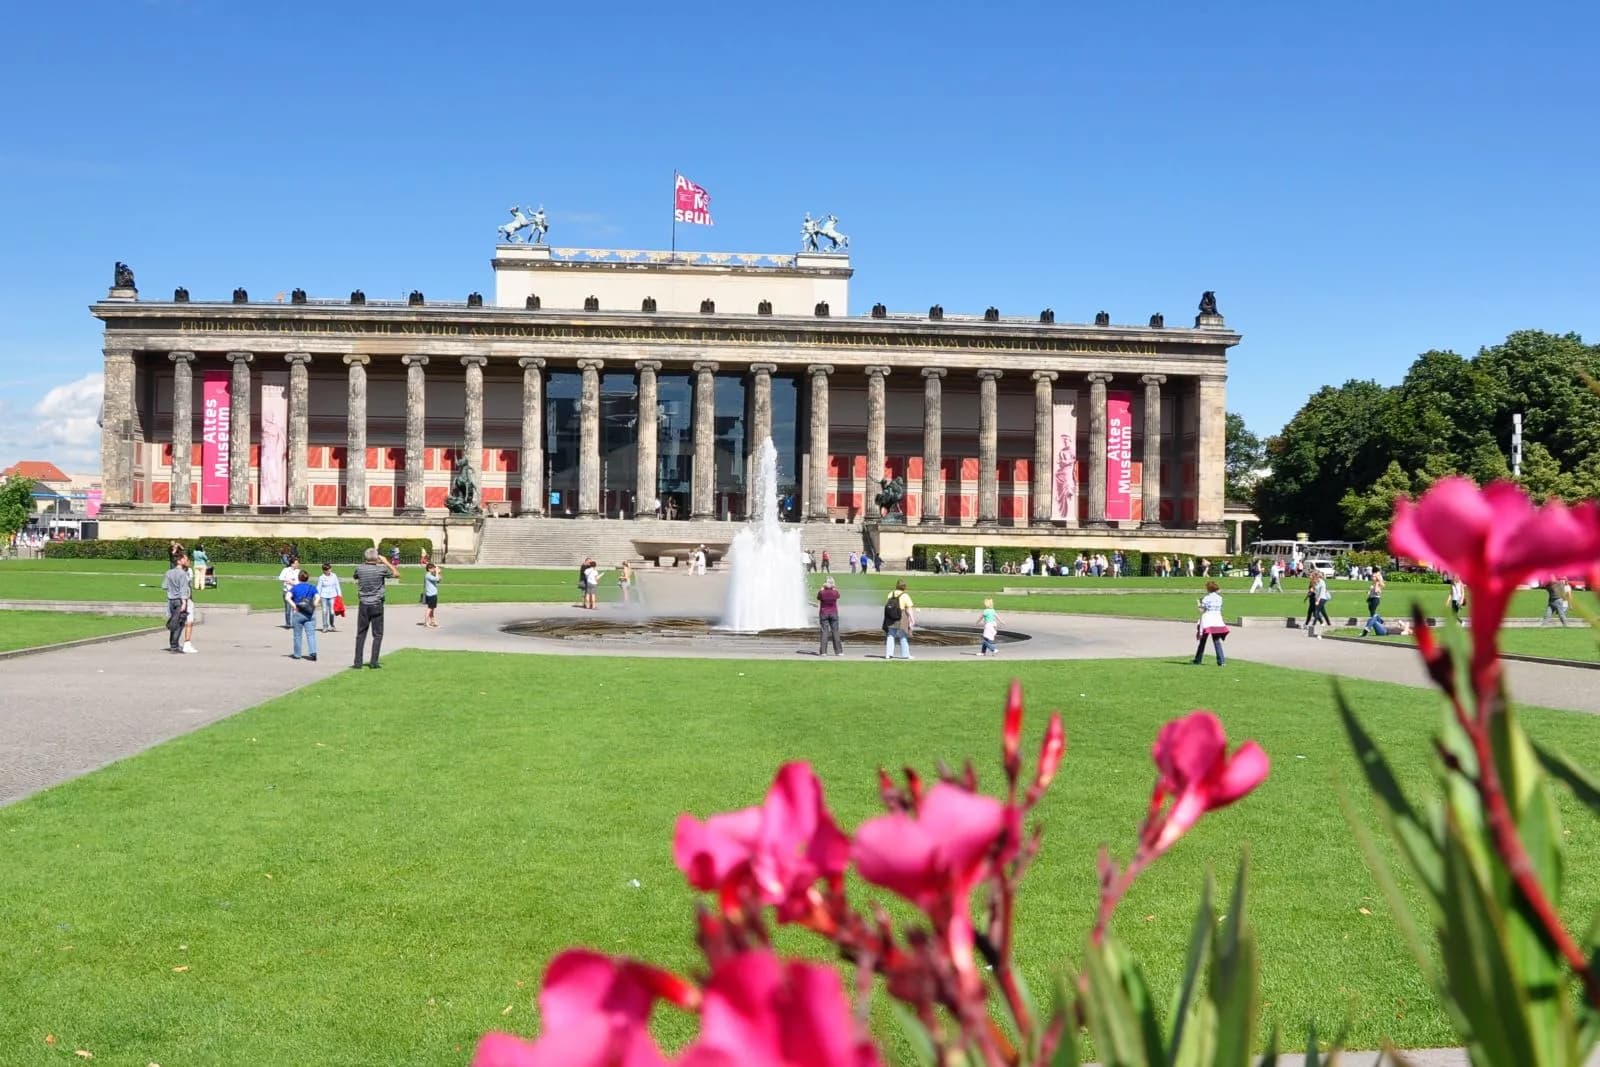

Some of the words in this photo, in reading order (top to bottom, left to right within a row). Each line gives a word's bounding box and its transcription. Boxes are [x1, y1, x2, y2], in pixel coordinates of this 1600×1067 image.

[180, 320, 270, 332] FRIDERICVS
[375, 323, 391, 335] III
[401, 324, 459, 336] STVDIO
[470, 326, 585, 338] ANTIQVITATIS
[592, 328, 694, 341] OMNIGENAE
[702, 331, 721, 342] ET
[728, 332, 788, 344] ARTIVM
[796, 334, 889, 346] LIBERALIVM
[897, 337, 960, 348] MVSEVM
[967, 339, 1057, 352] CONSTITVIT
[204, 399, 217, 444] Altes
[215, 407, 229, 478] Museum
[1108, 418, 1121, 461] Altes
[1118, 426, 1132, 494] Museum
